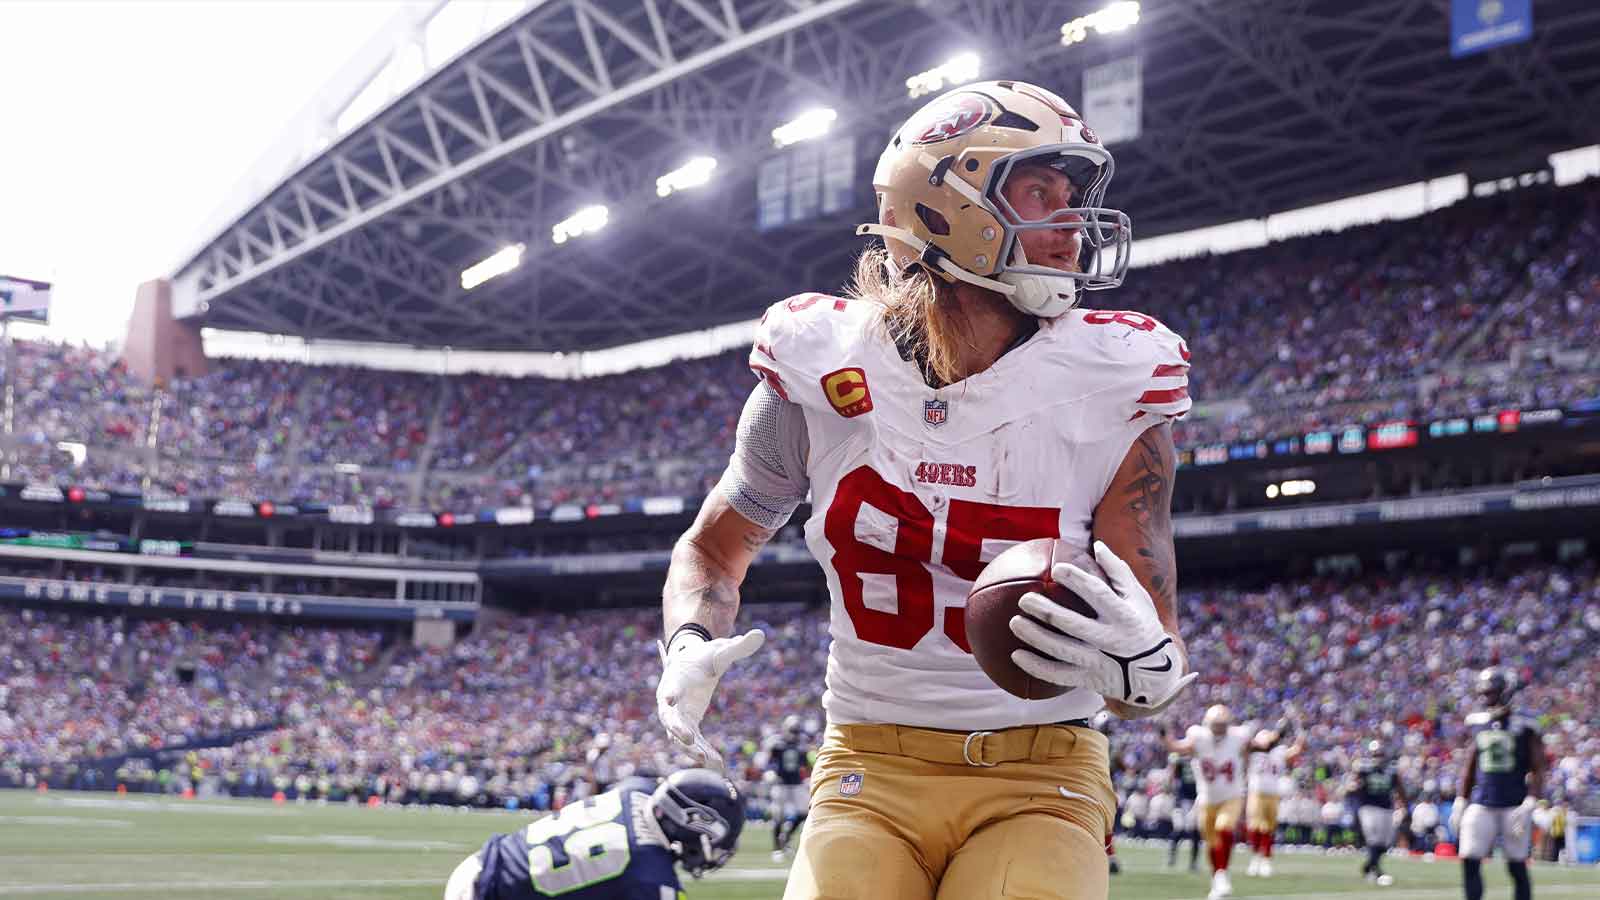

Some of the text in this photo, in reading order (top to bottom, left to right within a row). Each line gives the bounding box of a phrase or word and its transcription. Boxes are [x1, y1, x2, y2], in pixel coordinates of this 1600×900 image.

[826, 371, 867, 408] C
[926, 409, 946, 423] NFL
[914, 462, 977, 488] 49ERS
[824, 464, 1061, 654] 85
[24, 581, 109, 604] HOME
[128, 587, 161, 606] OF
[184, 589, 236, 612] THE
